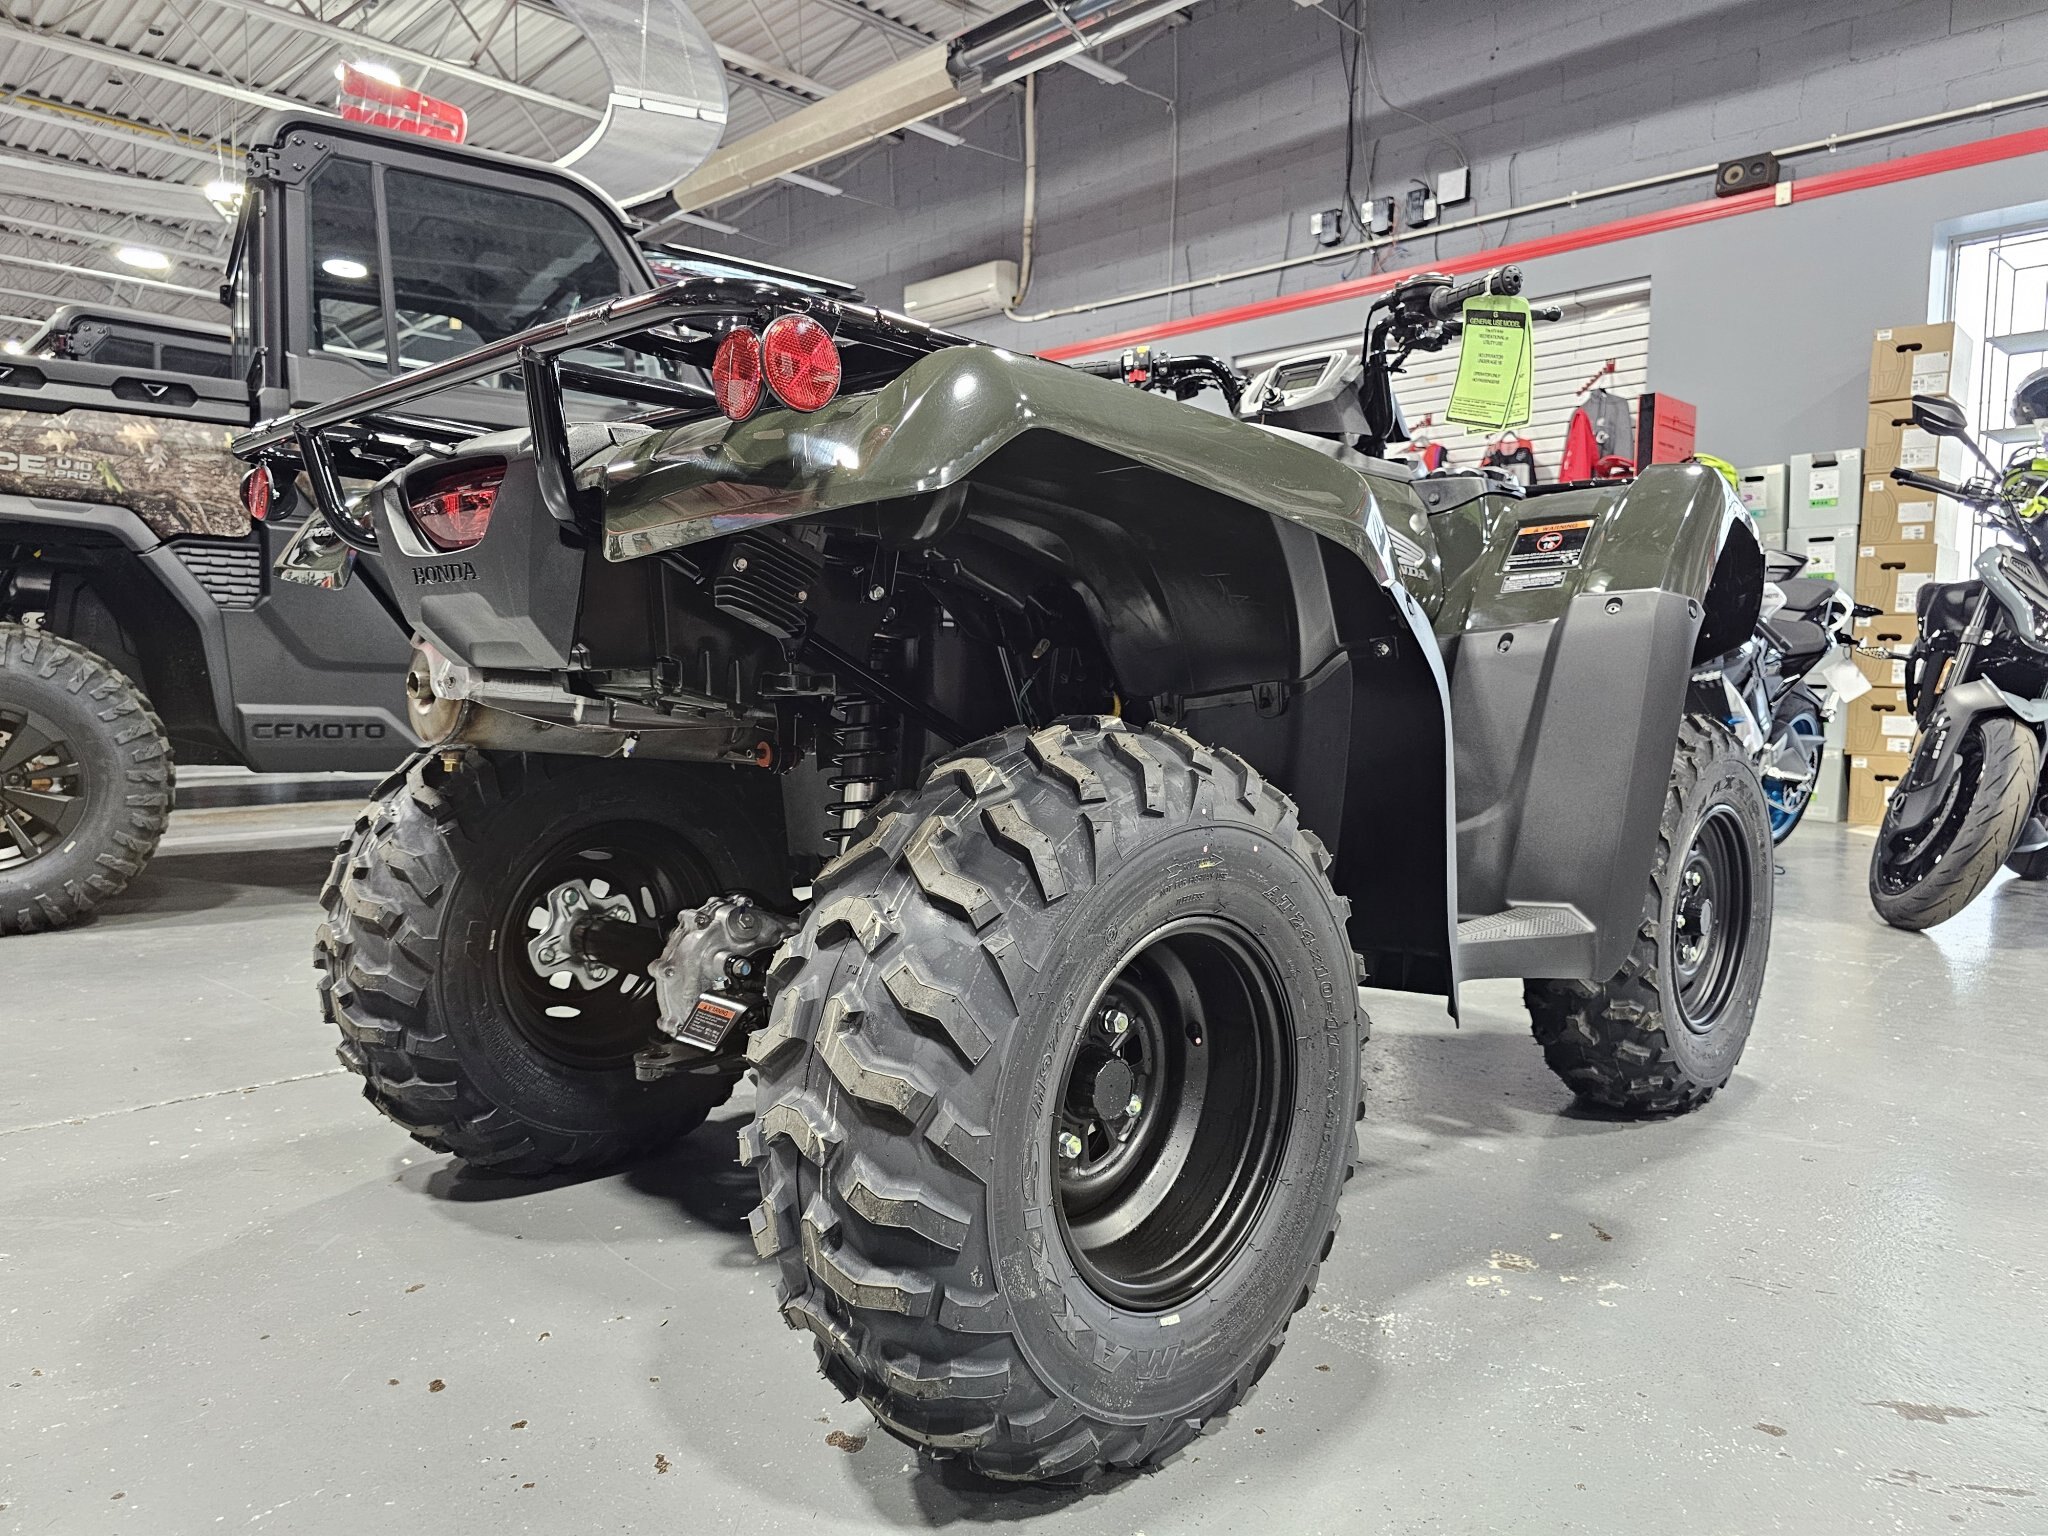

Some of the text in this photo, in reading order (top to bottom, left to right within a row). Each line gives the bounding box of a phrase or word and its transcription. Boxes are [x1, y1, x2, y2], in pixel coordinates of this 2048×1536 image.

[1469, 317, 1521, 328] GENERAL USE MODEL
[54, 469, 92, 481] PRO
[1542, 523, 1579, 532] WARNING
[412, 562, 480, 585] HONDA
[251, 722, 386, 740] CFMOTO
[1021, 1138, 1182, 1381] MAXXIS
